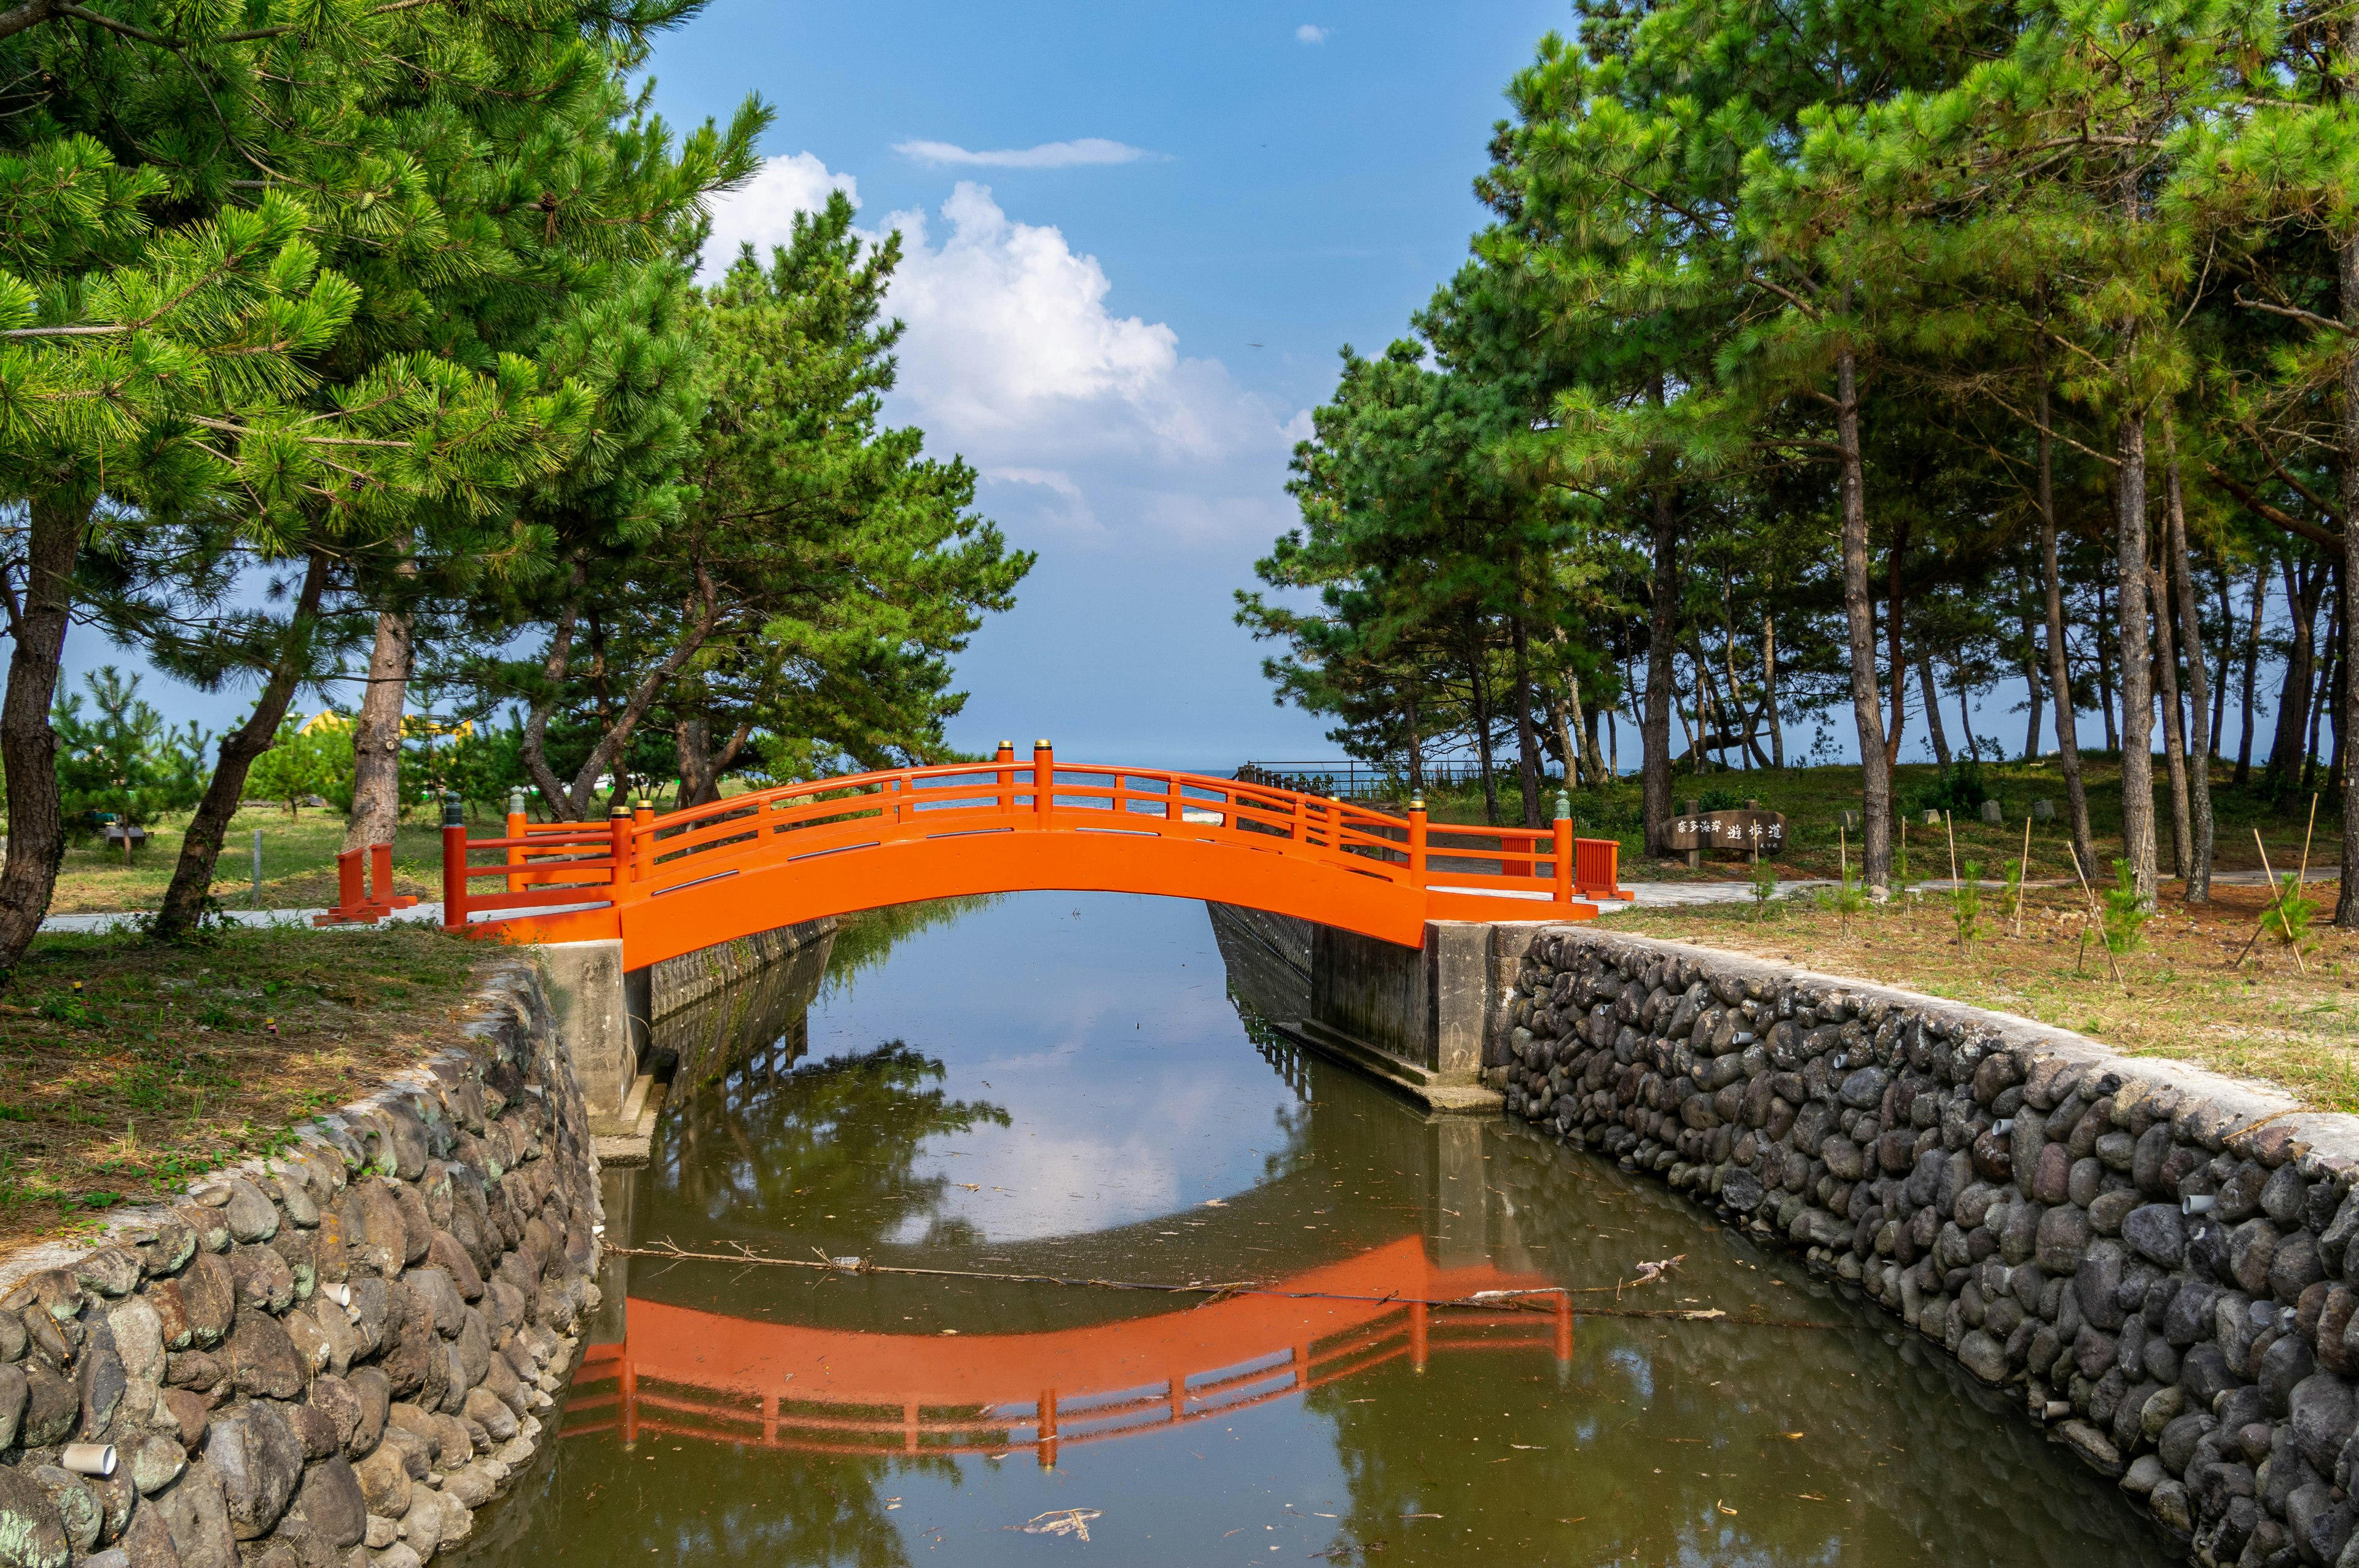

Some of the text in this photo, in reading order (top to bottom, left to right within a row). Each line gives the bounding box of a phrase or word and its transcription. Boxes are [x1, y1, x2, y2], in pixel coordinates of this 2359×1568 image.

[1677, 820, 1783, 840] 奈多海岸 遊歩道
